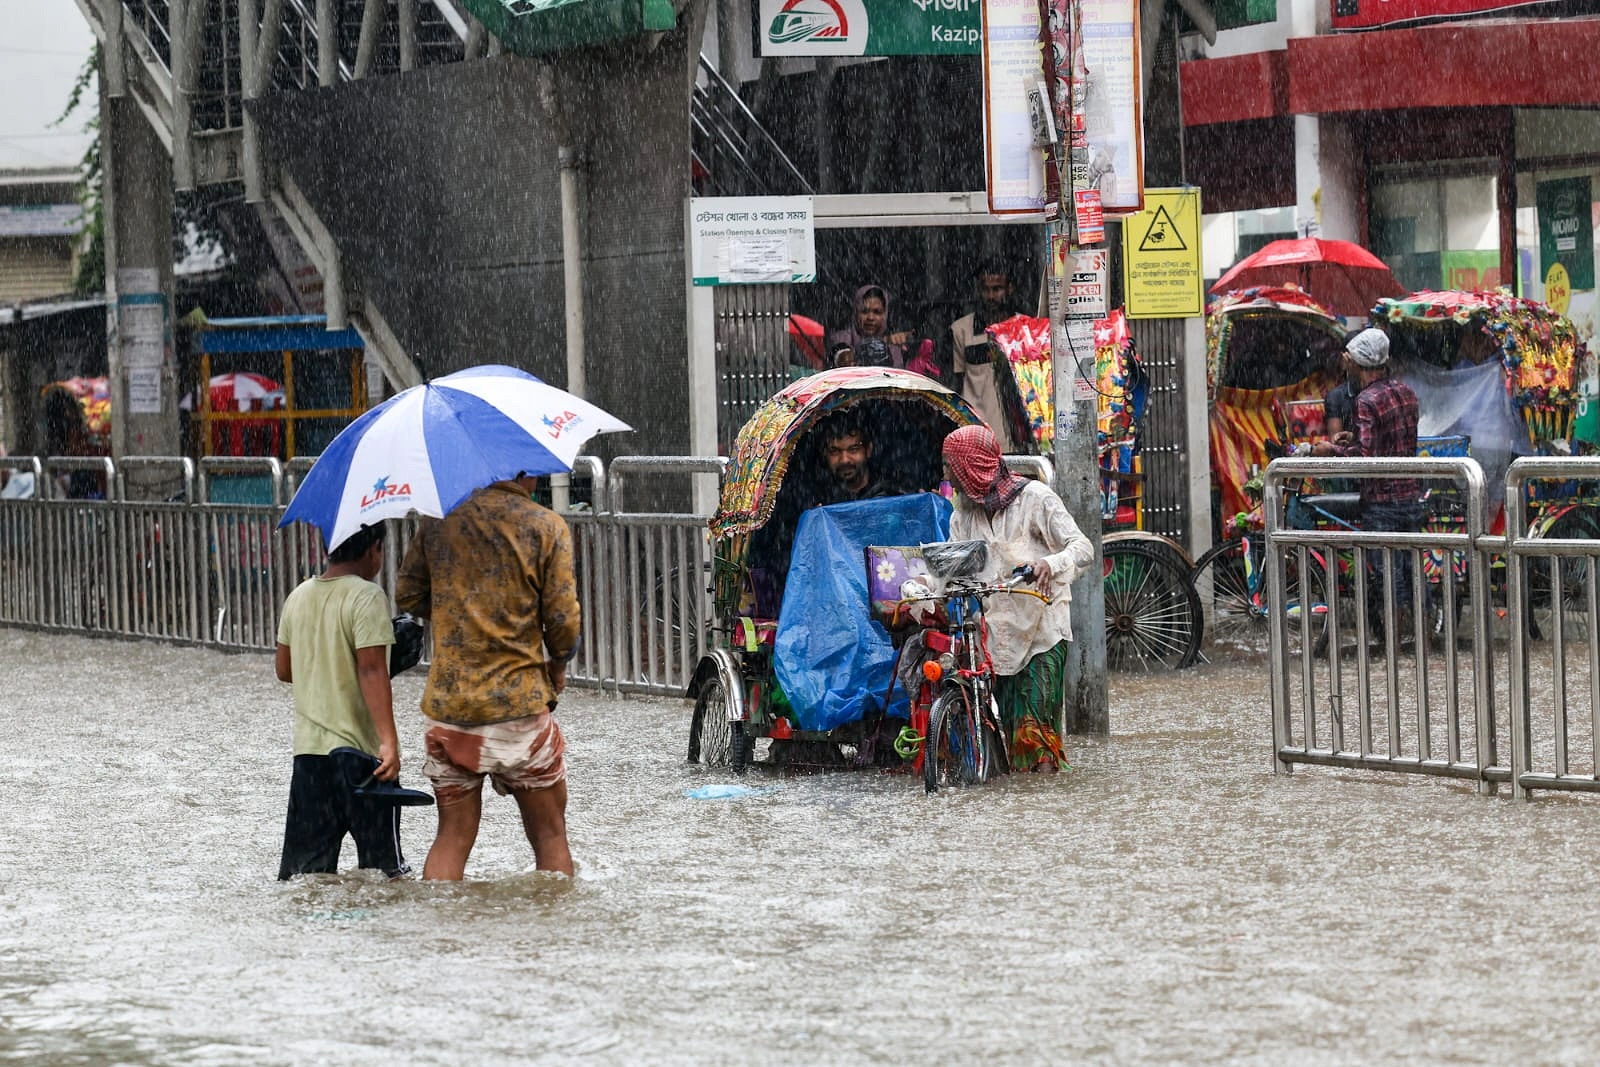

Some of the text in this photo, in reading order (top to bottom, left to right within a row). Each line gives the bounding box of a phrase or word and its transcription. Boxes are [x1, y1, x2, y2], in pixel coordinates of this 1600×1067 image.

[931, 25, 982, 45] Kazip
[696, 211, 724, 222] স্টেশন
[726, 211, 749, 222] খোলা
[751, 213, 758, 221] ও
[727, 229, 754, 237] Opening
[763, 228, 787, 236] Closing
[789, 227, 805, 235] Time
[547, 409, 577, 439] LIRA
[361, 483, 411, 508] LIRA
